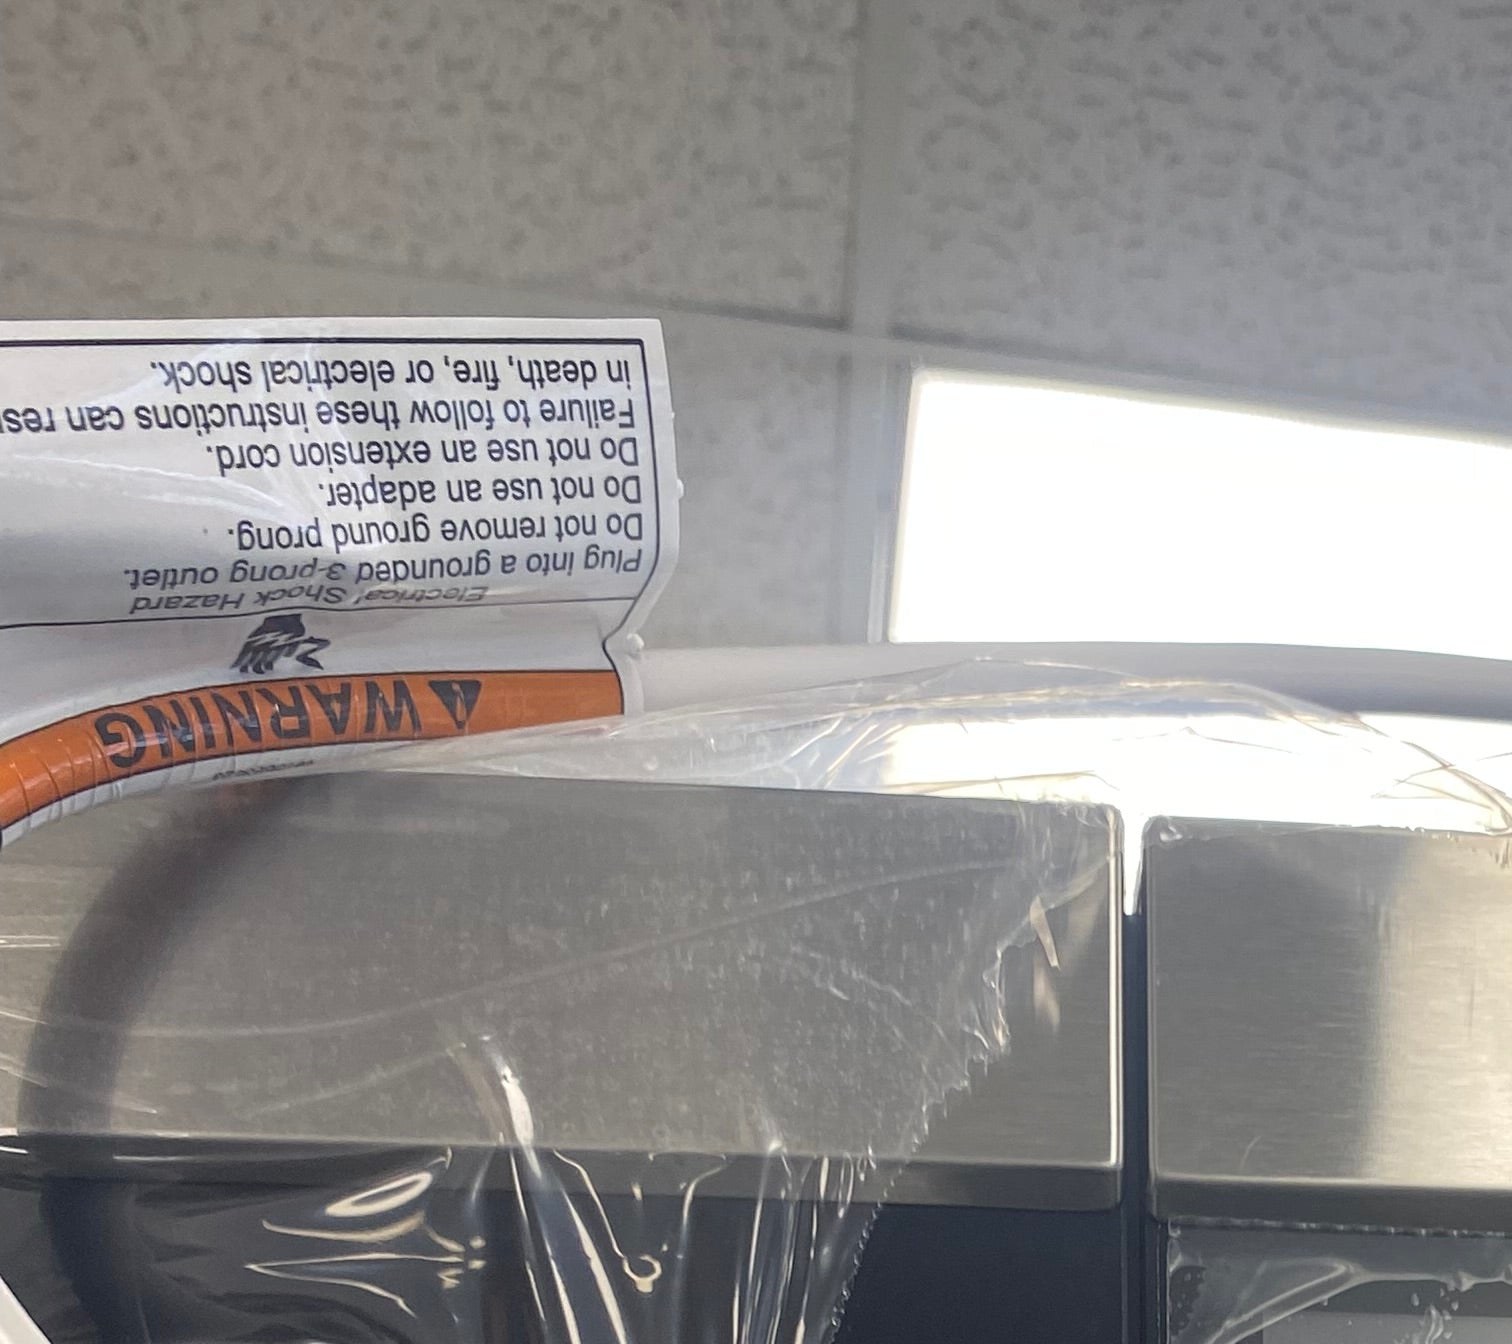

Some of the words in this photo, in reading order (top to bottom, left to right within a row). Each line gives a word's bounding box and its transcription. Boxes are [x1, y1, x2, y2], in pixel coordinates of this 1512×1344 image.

[150, 362, 251, 394] shock.
[260, 360, 394, 392] electrical
[405, 360, 434, 385] or
[443, 355, 500, 391] fire,
[507, 355, 597, 390] death,
[607, 360, 631, 390] in
[0, 408, 56, 435] res
[65, 407, 124, 433] can
[134, 402, 308, 437] instructions
[316, 401, 400, 431] these
[410, 400, 495, 431] follow
[503, 399, 530, 428] to
[539, 398, 635, 429] Failure
[207, 445, 280, 478] cord.
[290, 440, 431, 473] extension
[441, 440, 476, 464] an
[487, 439, 537, 463] use
[546, 438, 590, 468] not
[600, 437, 638, 467] Do
[319, 474, 436, 511] adapter.
[446, 480, 482, 503] an
[492, 478, 543, 502] use
[551, 477, 594, 506] not
[604, 476, 641, 504] Do
[227, 518, 322, 552] prong.
[331, 513, 430, 554] ground
[440, 517, 546, 541] remove
[554, 515, 596, 543] not
[606, 513, 643, 541] Do
[230, 558, 346, 584] 3-prong
[355, 549, 491, 584] grounded
[501, 555, 517, 573] a
[526, 551, 574, 575] into
[584, 544, 643, 573] Plug
[123, 567, 218, 590] outlet.
[129, 593, 245, 614] Hazard
[253, 585, 347, 607] Shock
[94, 681, 420, 768] WARNING
